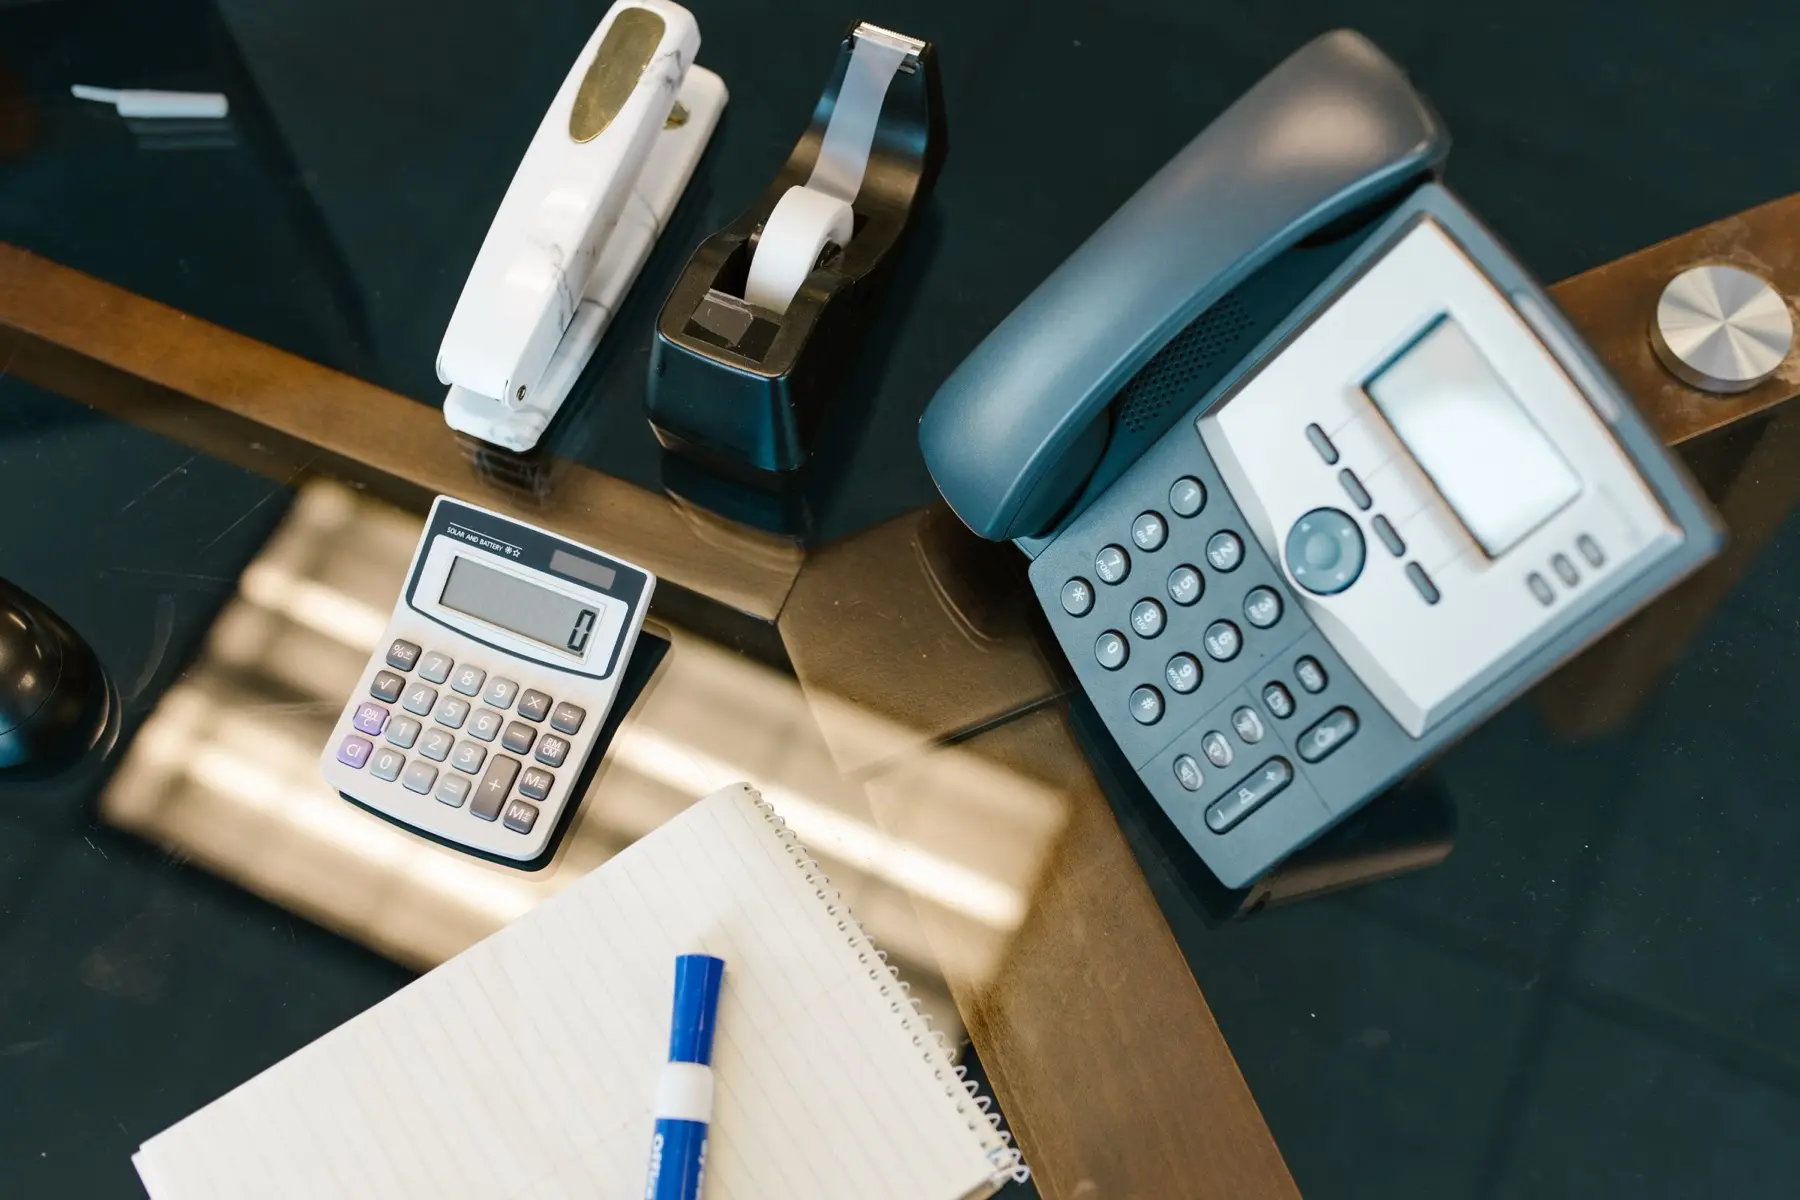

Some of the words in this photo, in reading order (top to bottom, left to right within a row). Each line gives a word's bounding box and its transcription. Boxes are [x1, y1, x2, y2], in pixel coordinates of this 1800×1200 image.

[1184, 488, 1196, 501] 1
[1145, 524, 1158, 535] 4
[446, 526, 466, 539] SOLAR
[465, 534, 479, 543] AND
[479, 538, 504, 552] BATTERY
[1219, 541, 1235, 558] 2
[1107, 554, 1121, 566] 7
[1096, 559, 1114, 581] PQRS
[1180, 574, 1196, 590] 5
[1258, 597, 1273, 612] 3
[1143, 608, 1157, 622] 8
[566, 608, 597, 651] 0
[1135, 616, 1148, 630] TUV
[1218, 631, 1233, 645] 6
[1106, 641, 1119, 654] 0
[427, 657, 441, 672] 7
[1180, 664, 1192, 678] 9
[461, 671, 475, 685] 8
[411, 690, 425, 705] 4
[494, 684, 507, 698] 9
[364, 708, 379, 719] ON
[445, 702, 457, 716] 5
[478, 715, 490, 729] 6
[398, 722, 407, 737] 1
[427, 736, 441, 750] 2
[546, 738, 562, 749] RM
[460, 749, 474, 763] 3
[542, 747, 557, 758] CM
[380, 754, 392, 769] 0
